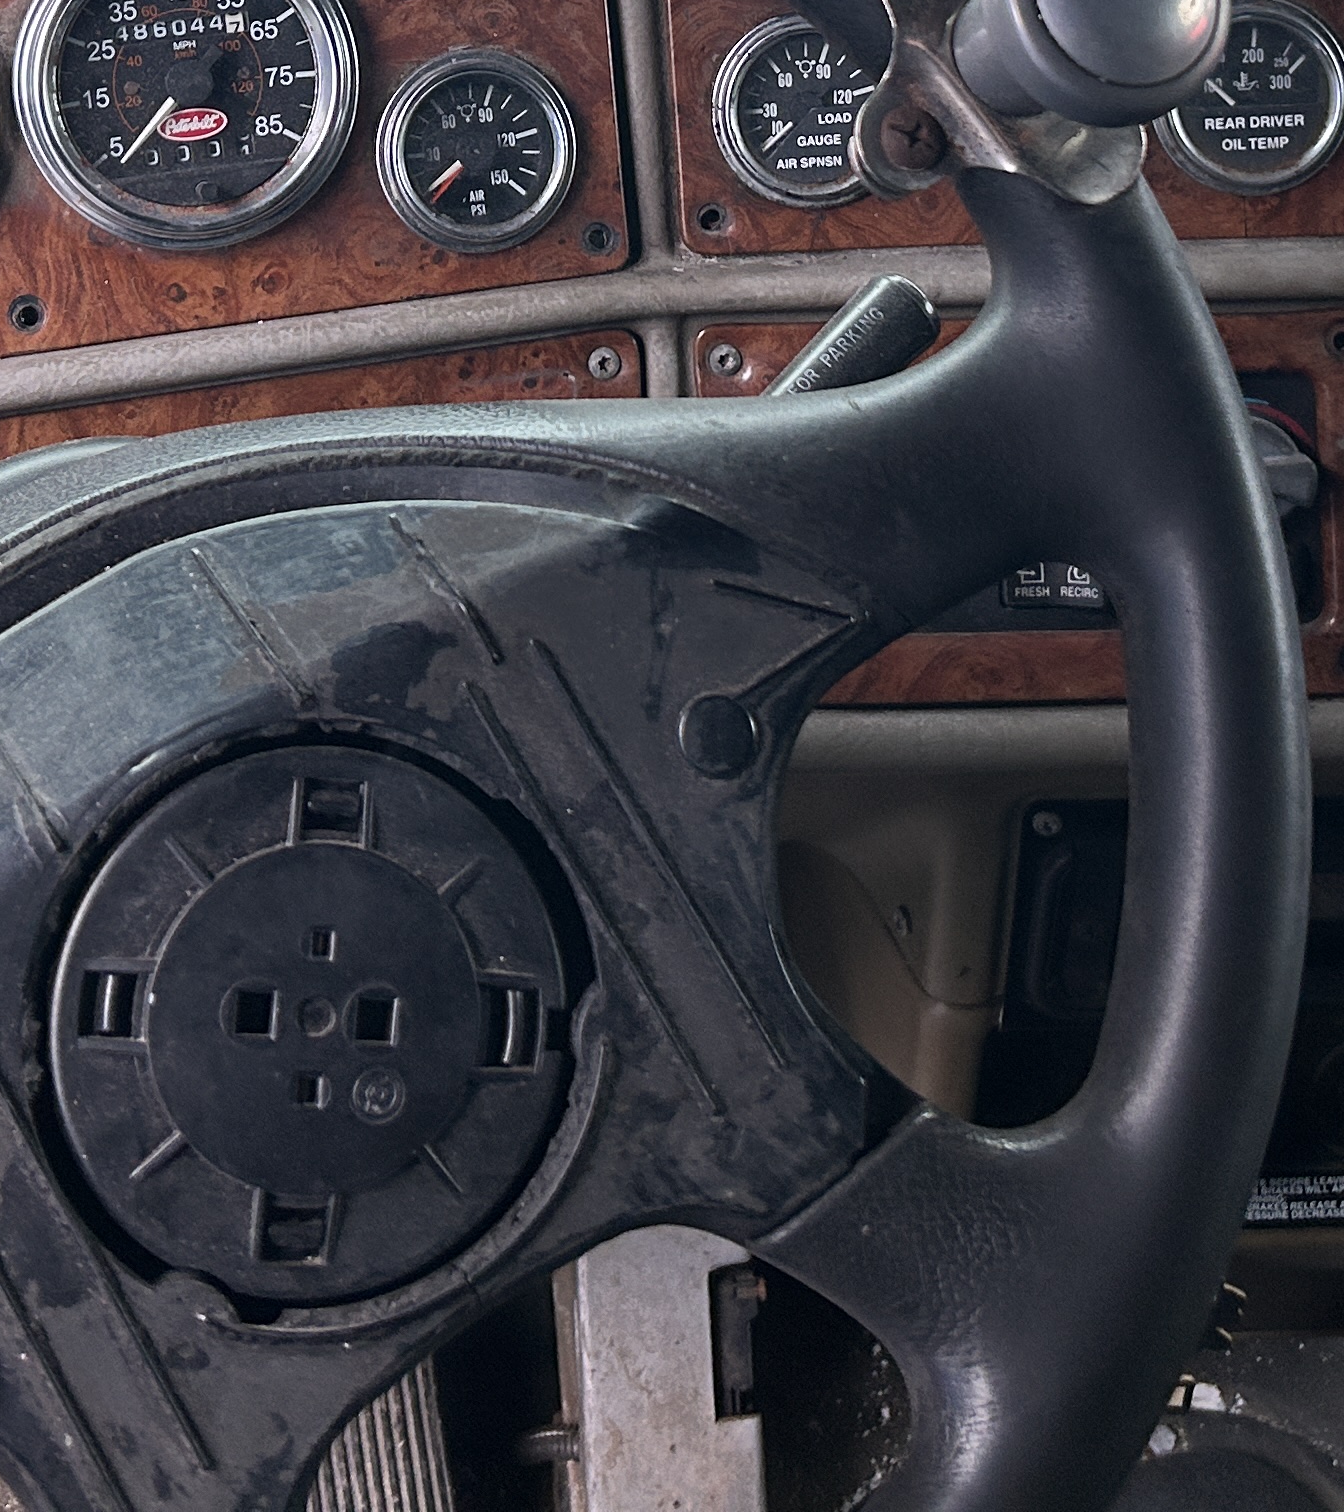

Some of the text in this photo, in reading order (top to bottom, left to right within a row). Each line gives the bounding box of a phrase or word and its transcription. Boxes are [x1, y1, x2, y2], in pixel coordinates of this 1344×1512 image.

[108, 0, 137, 22] 35
[141, 4, 158, 17] 60
[250, 18, 278, 40] 65
[86, 40, 116, 62] 25
[173, 40, 196, 50] MPH
[126, 54, 142, 67] 40
[1242, 48, 1264, 64] 200
[265, 65, 293, 88] 75
[816, 63, 832, 80] 90
[778, 72, 793, 88] 60
[1269, 74, 1292, 90] 300
[83, 87, 110, 109] 15
[125, 95, 140, 108] 20
[833, 88, 852, 105] 120
[478, 108, 494, 123] 90
[762, 102, 778, 118] 30
[164, 114, 220, 136] Peterbilt
[256, 114, 283, 136] 85
[442, 114, 456, 129] 60
[818, 112, 852, 126] LOAD
[1205, 114, 1305, 130] REAR DRIVER
[771, 120, 784, 136] 10
[110, 137, 124, 158] 5
[497, 132, 516, 148] 120
[797, 134, 842, 148] GAUGE
[1222, 136, 1290, 152] OIL TEMP
[426, 146, 440, 161] 30
[776, 155, 842, 170] AIR SPNSN
[490, 169, 508, 186] 150
[470, 190, 486, 202] AIR
[470, 204, 486, 217] PSI
[820, 306, 886, 368] PARKING
[1014, 586, 1098, 599] FRESH RECIRC
